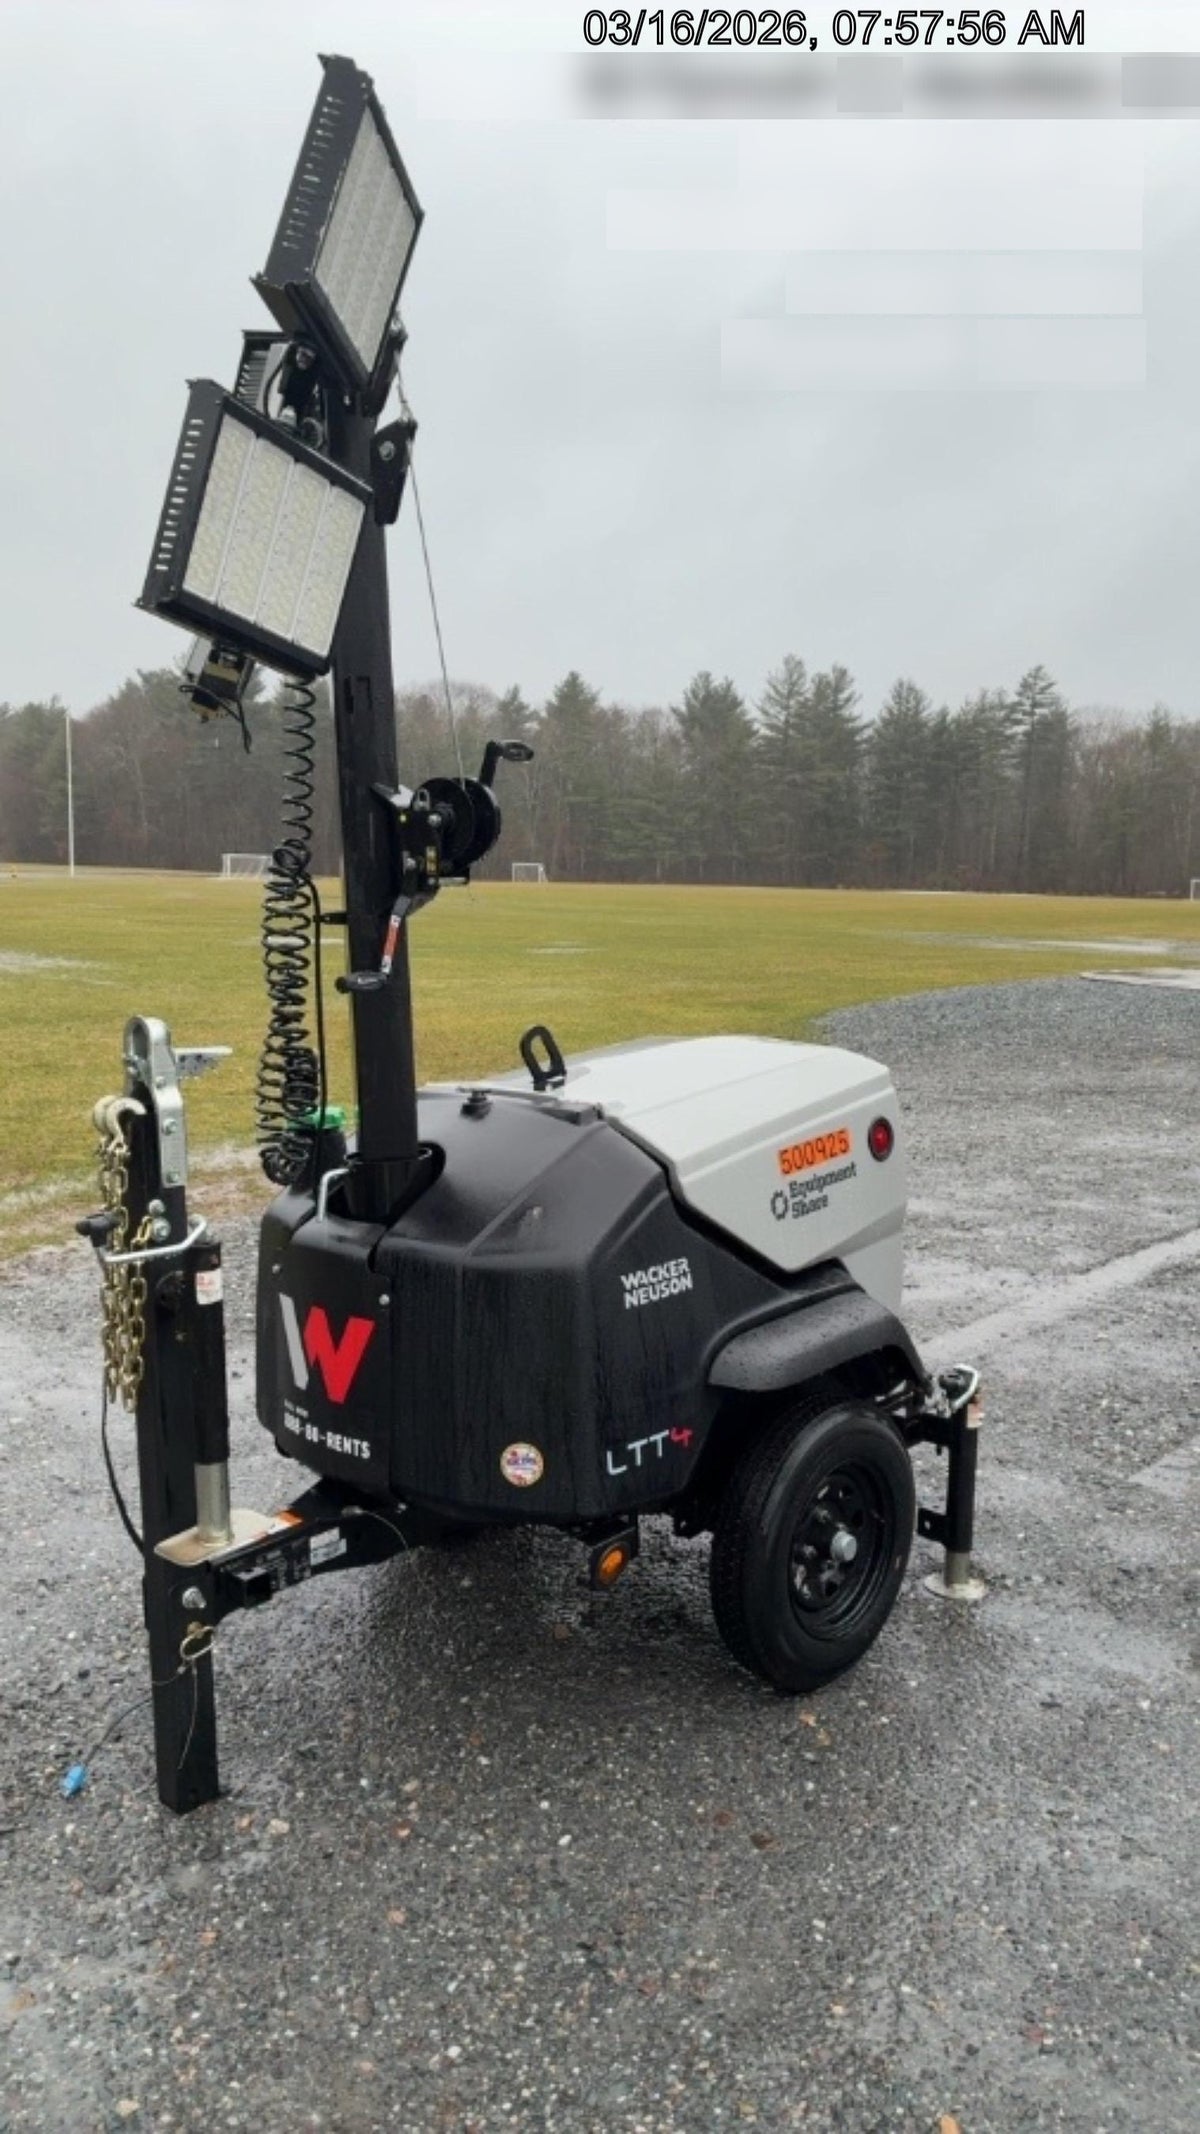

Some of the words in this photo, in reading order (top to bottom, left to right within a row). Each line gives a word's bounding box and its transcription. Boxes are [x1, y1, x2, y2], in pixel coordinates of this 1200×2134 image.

[779, 1129, 850, 1175] 500925
[789, 1161, 857, 1199] Equipment
[791, 1194, 829, 1219] Share
[620, 1257, 690, 1290] WACKER
[623, 1273, 693, 1309] NEUSON
